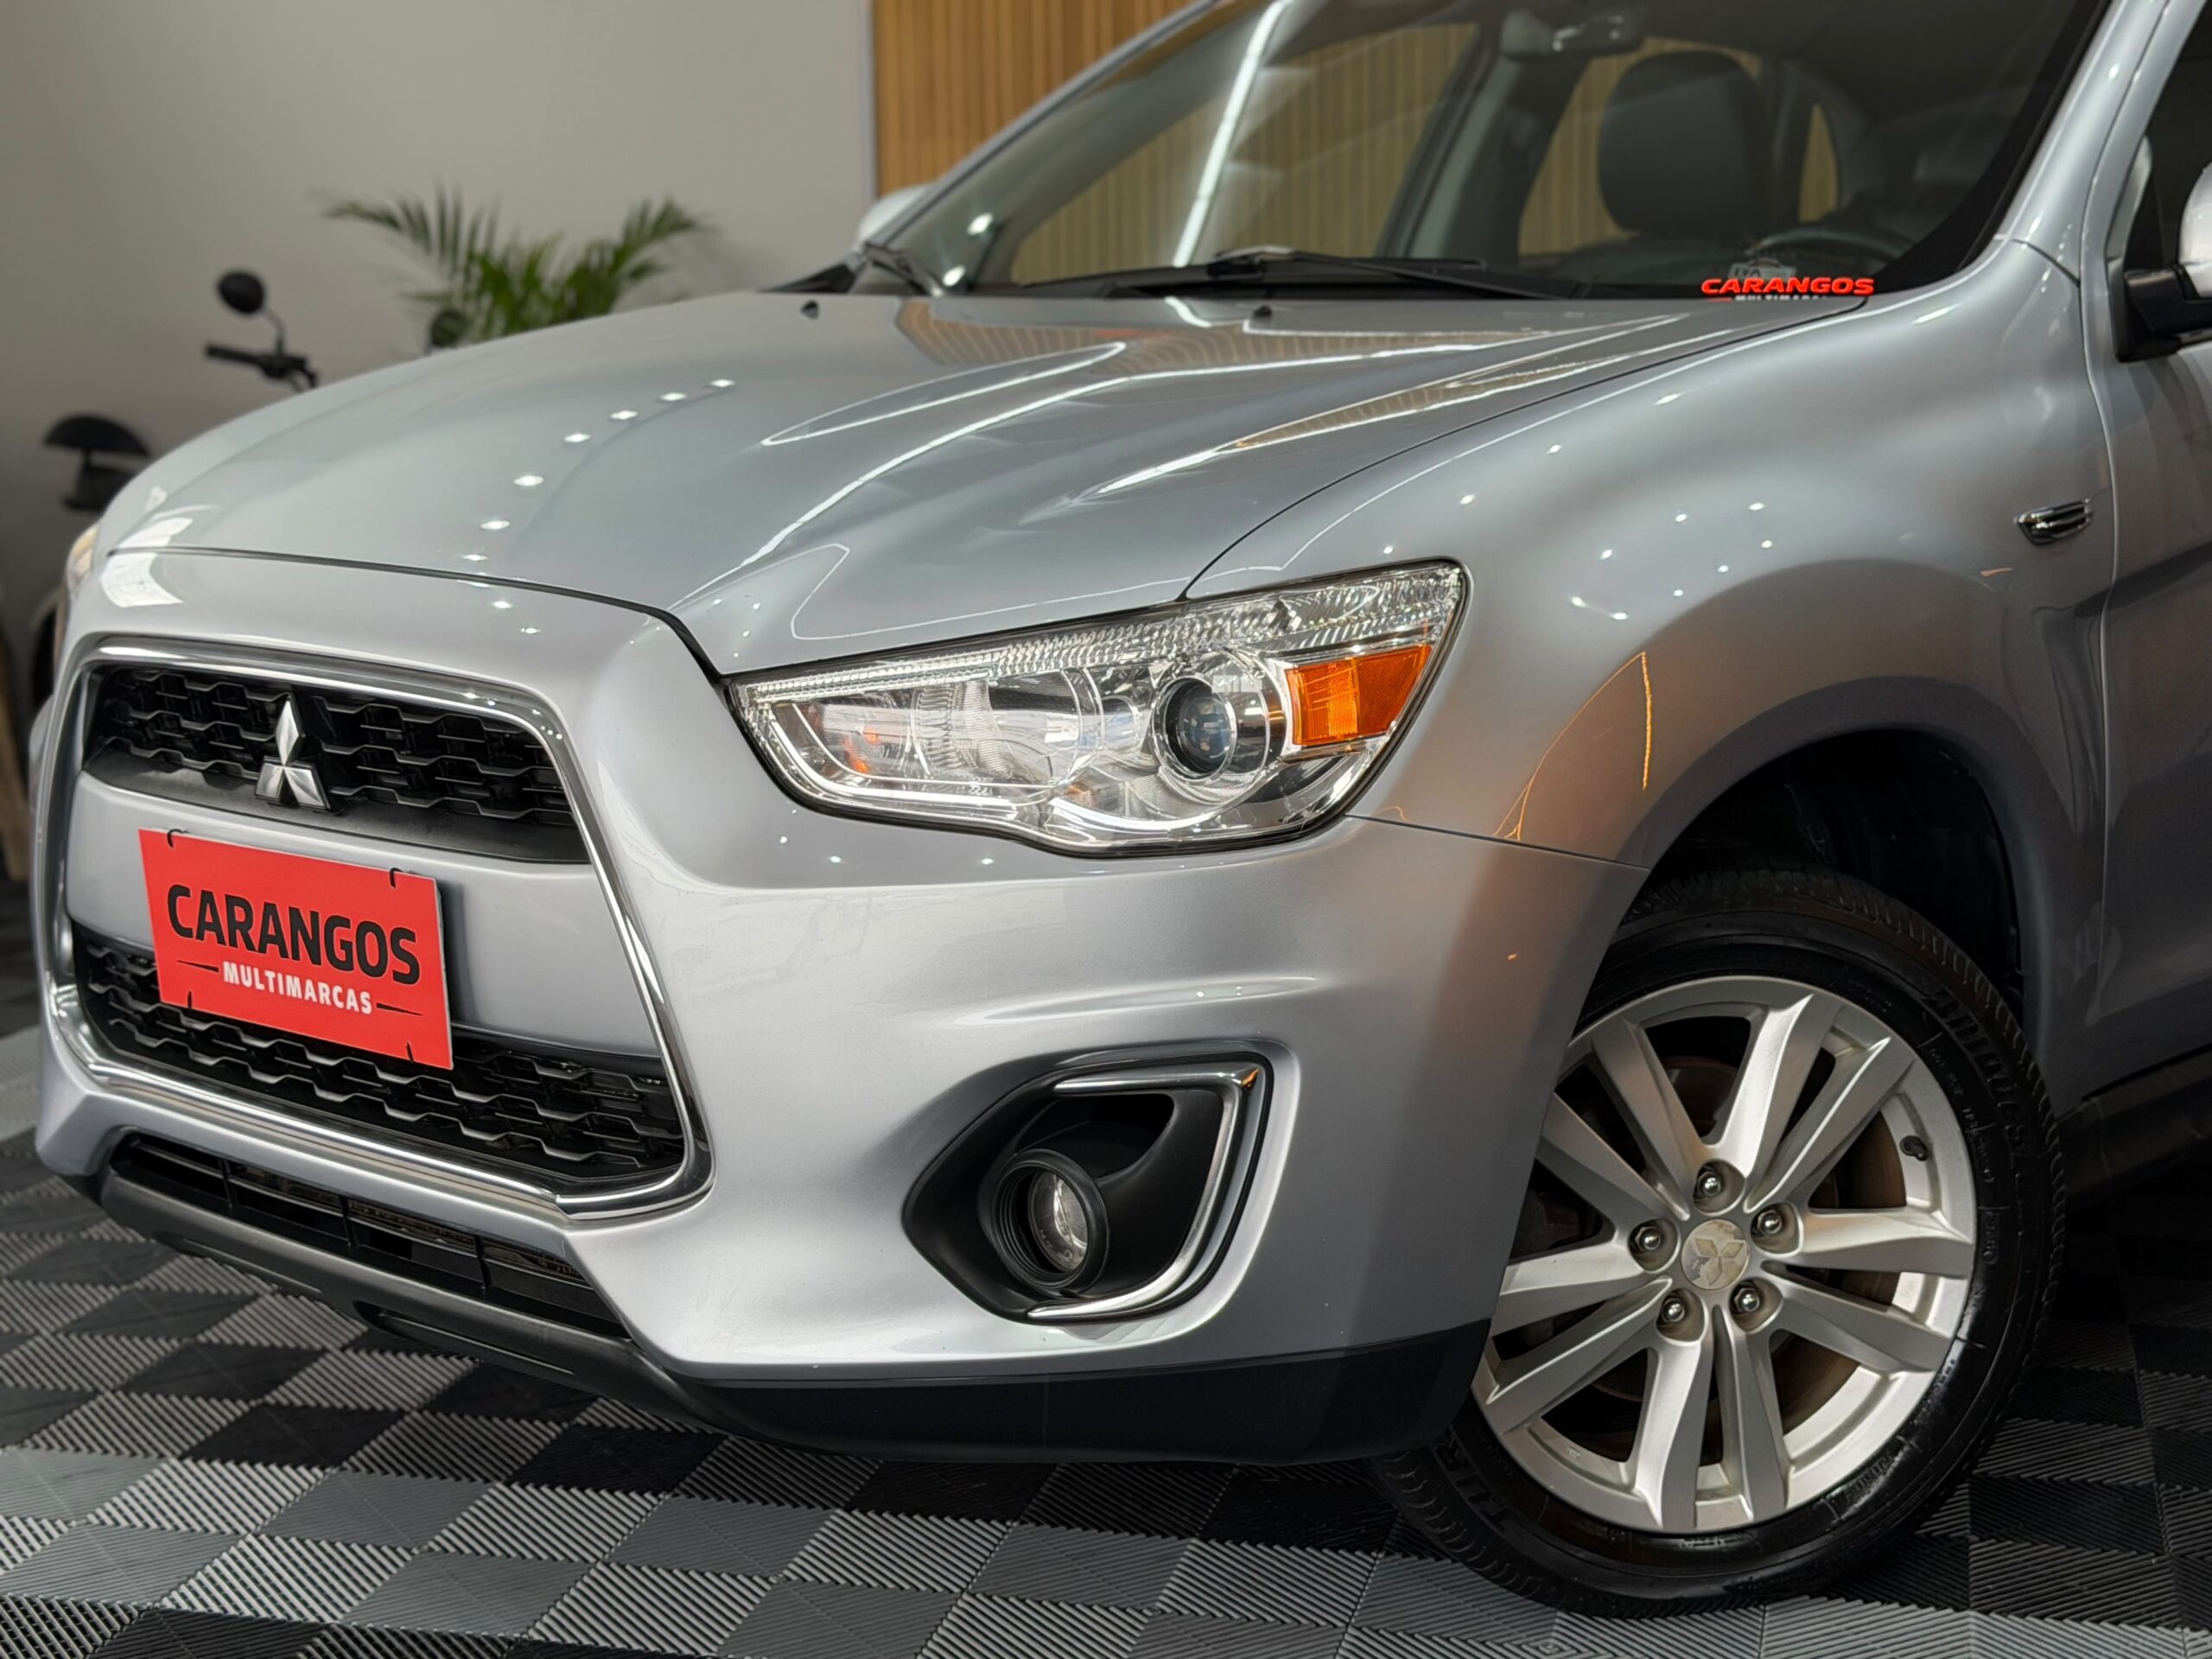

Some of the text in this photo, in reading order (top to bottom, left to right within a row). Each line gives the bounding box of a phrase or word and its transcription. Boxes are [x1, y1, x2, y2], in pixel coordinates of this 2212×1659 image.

[1700, 276, 1874, 296] CARANGOS
[167, 884, 421, 985] CARANGOS
[223, 961, 373, 1014] MULTIMARCAS
